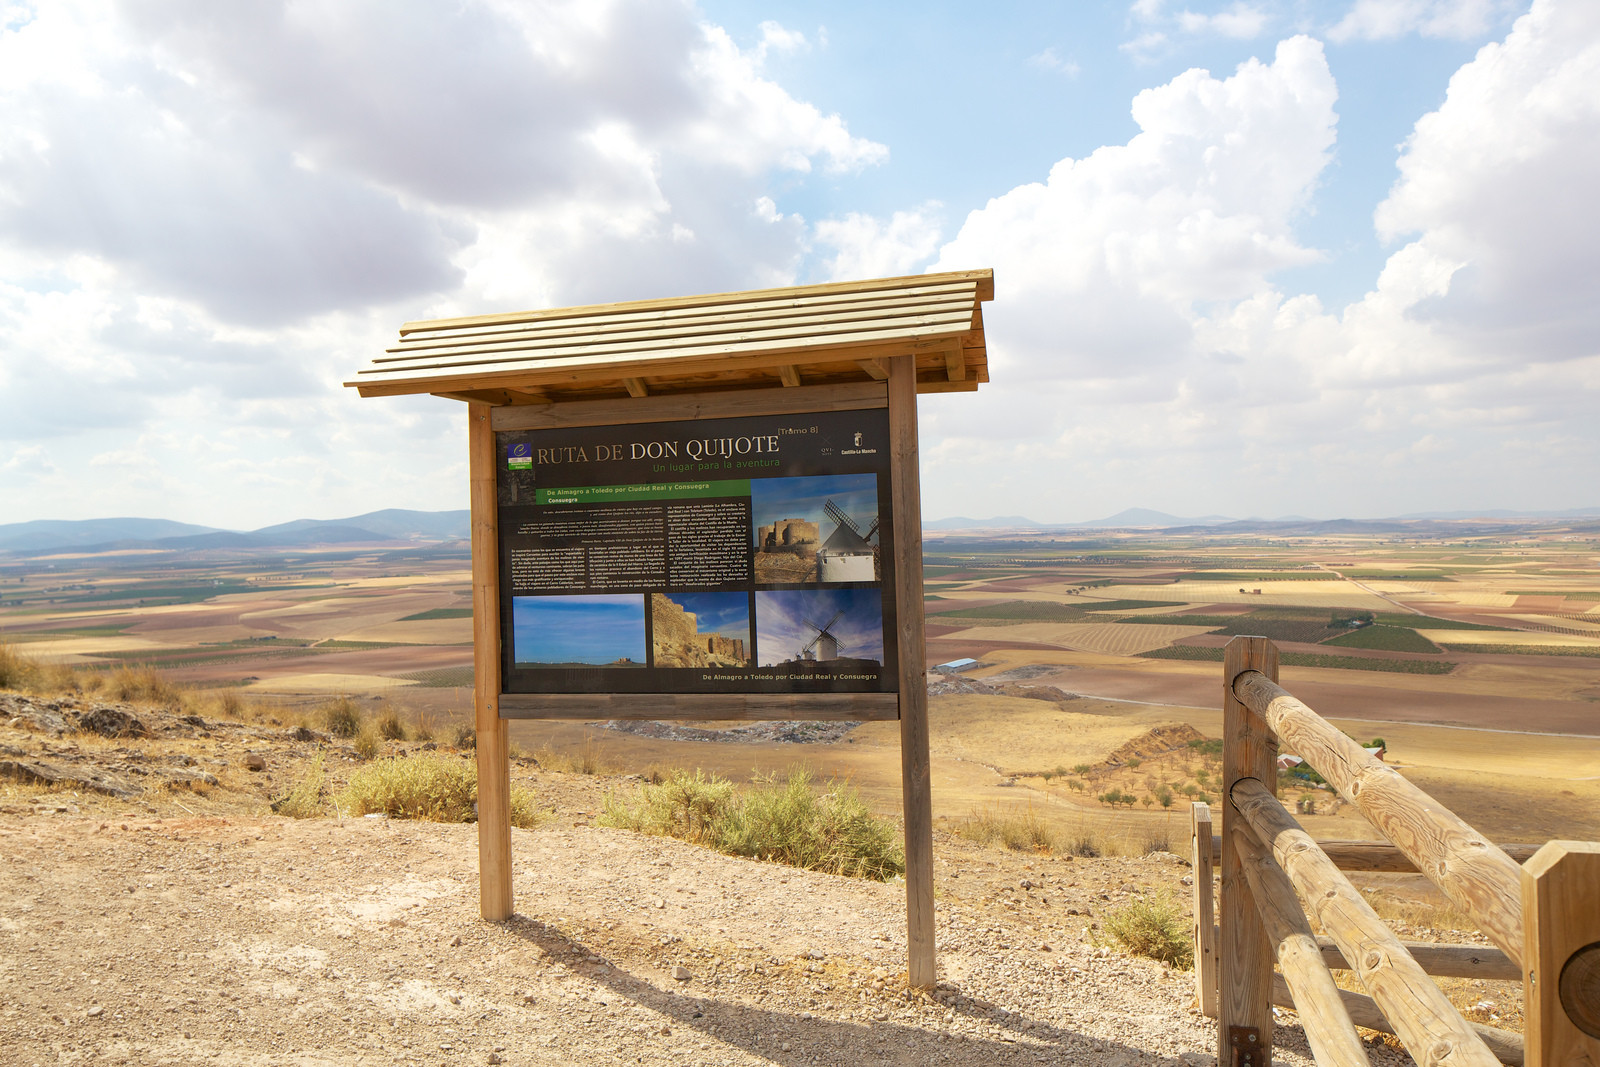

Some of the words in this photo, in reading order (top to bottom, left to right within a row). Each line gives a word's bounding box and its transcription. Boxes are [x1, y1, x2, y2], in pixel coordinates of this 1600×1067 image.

[537, 446, 589, 464] RUTA
[594, 444, 624, 461] DE
[630, 440, 679, 460] DON
[686, 435, 780, 461] QUIJOTE
[652, 464, 666, 473] Un
[669, 462, 694, 473] lugar
[698, 462, 720, 473] para
[723, 460, 733, 469] la
[736, 459, 780, 469] aventura
[674, 483, 710, 491] Consuegra
[713, 674, 743, 682] Almagro
[775, 674, 788, 682] por
[839, 673, 878, 681] Consuegra
